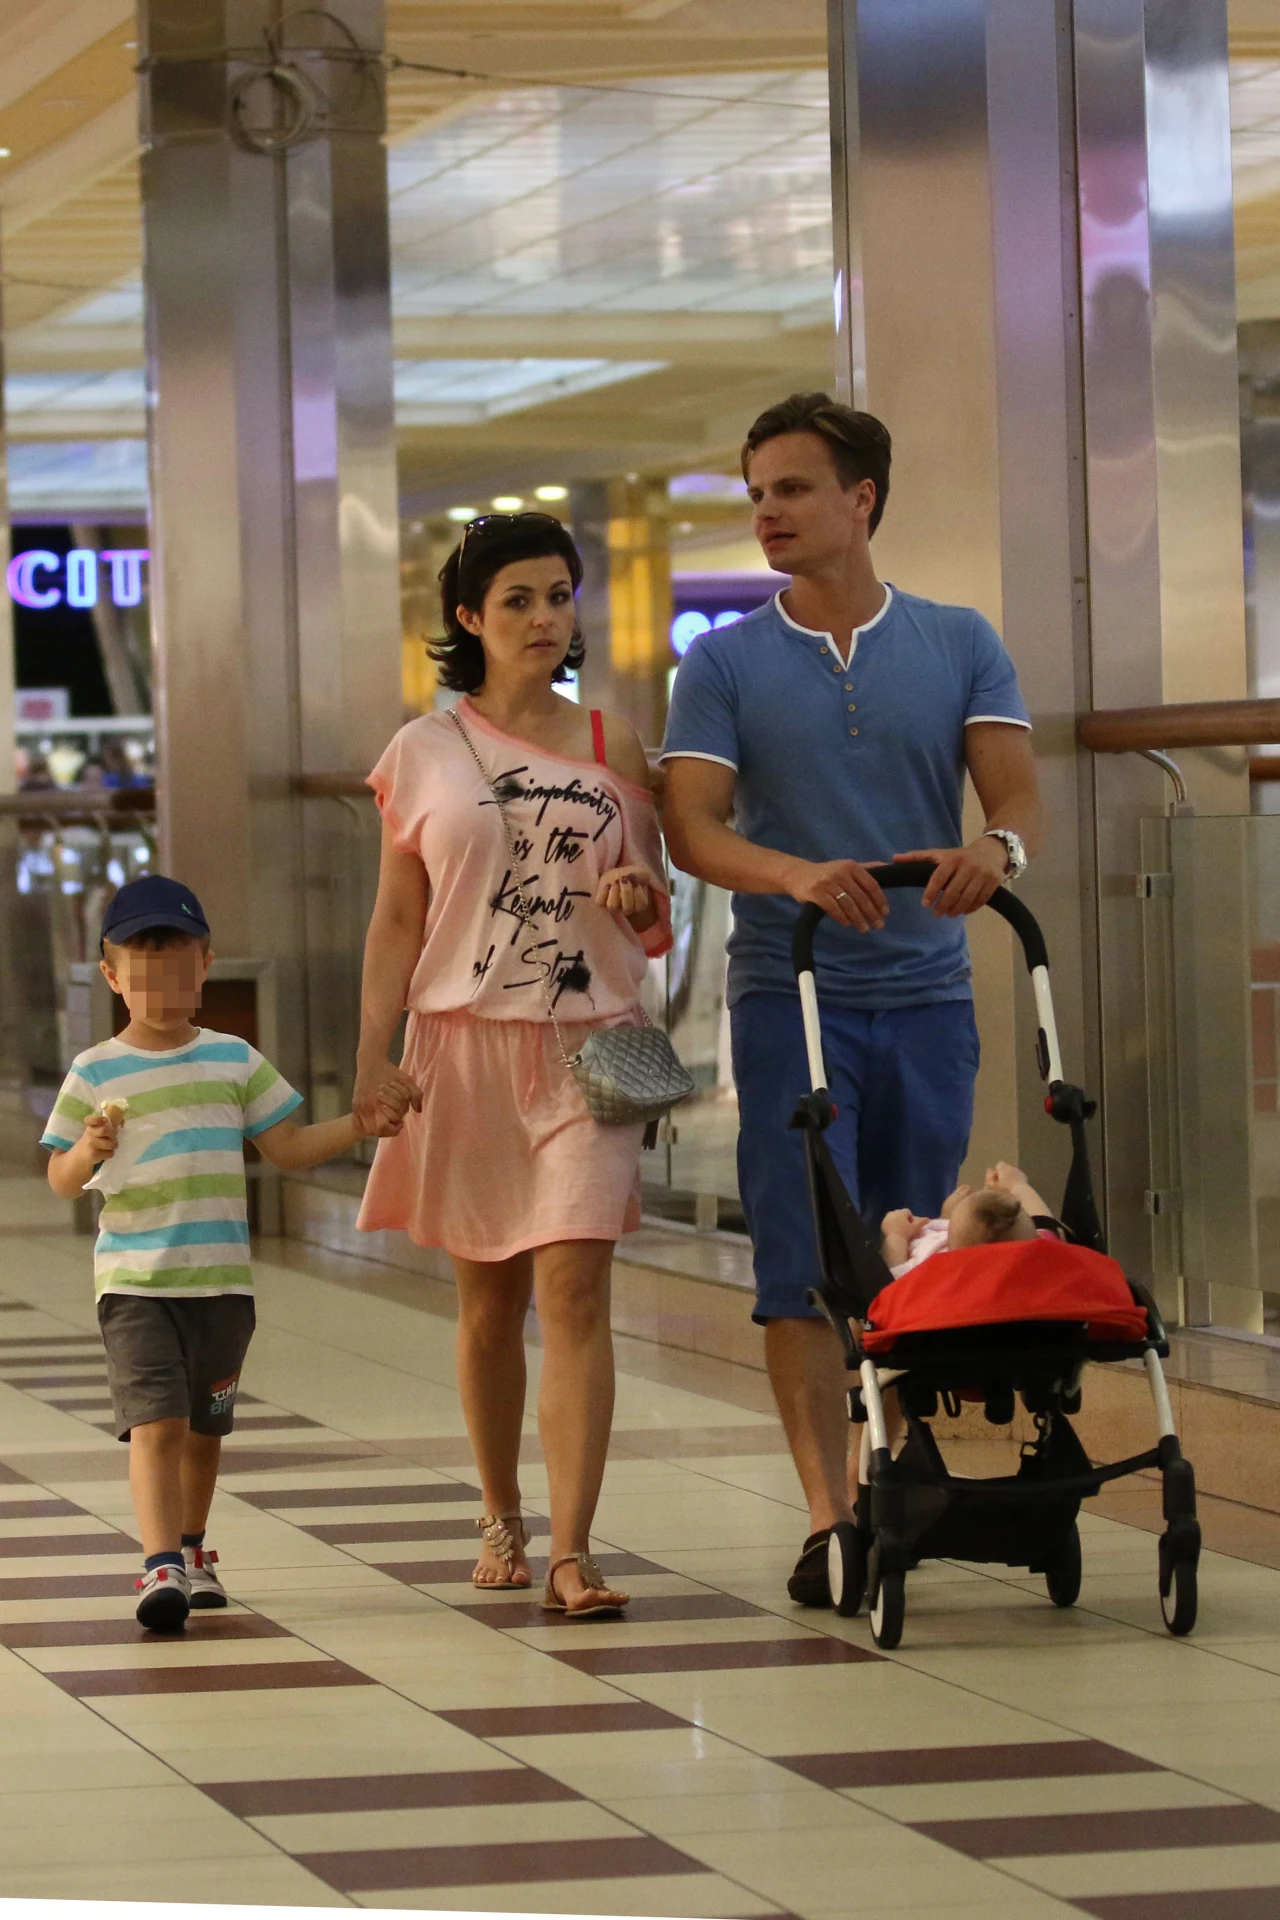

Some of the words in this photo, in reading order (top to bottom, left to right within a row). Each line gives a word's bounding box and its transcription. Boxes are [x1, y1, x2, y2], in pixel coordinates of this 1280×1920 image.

[478, 765, 617, 842] Simplicity
[513, 831, 534, 861] is
[543, 826, 589, 864] the
[489, 869, 592, 945] Keynote
[470, 944, 496, 998] of
